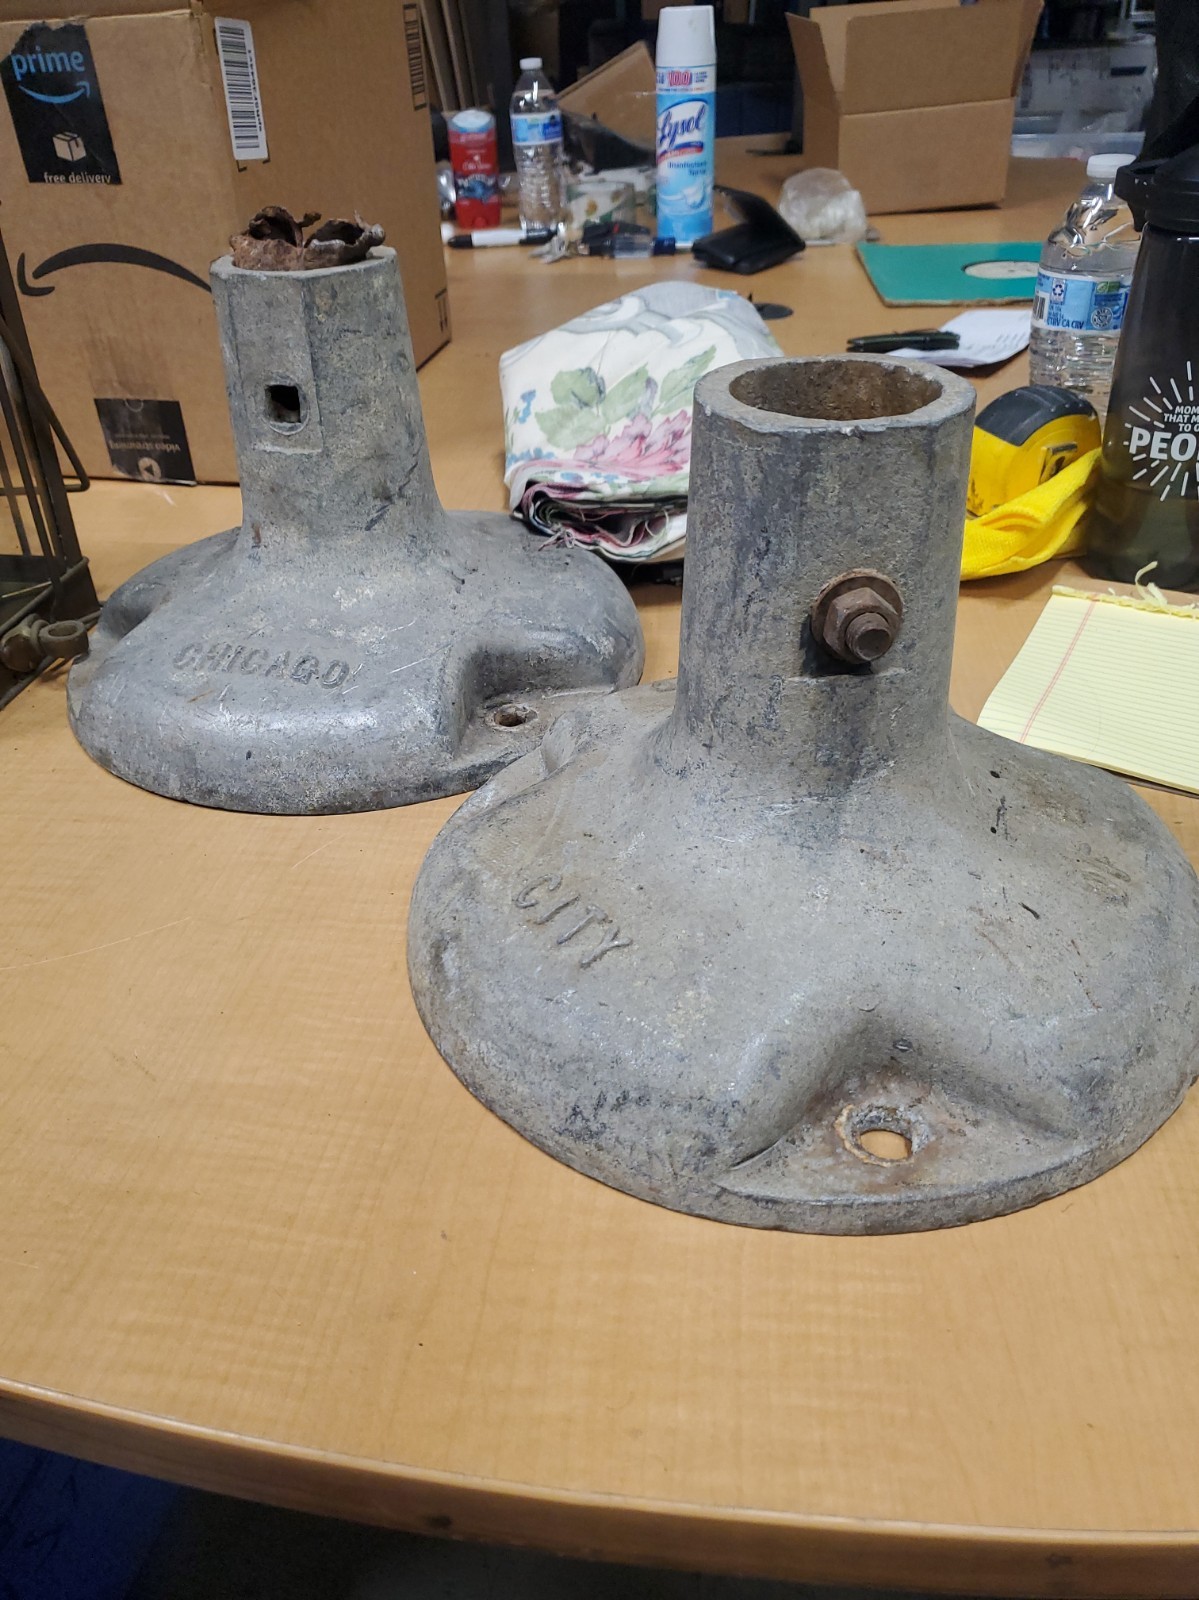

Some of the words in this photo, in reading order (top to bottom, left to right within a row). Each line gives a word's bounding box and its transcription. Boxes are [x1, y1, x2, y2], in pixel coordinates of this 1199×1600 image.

[10, 45, 86, 81] prime
[657, 103, 706, 149] Lysol
[43, 171, 66, 184] free
[68, 171, 112, 184] delivery
[1163, 413, 1190, 423] THAT
[1174, 405, 1199, 415] MOM
[1178, 423, 1192, 432] TO
[1128, 426, 1199, 462] PEO
[172, 642, 350, 689] CHICAGO
[515, 873, 633, 970] CITY
